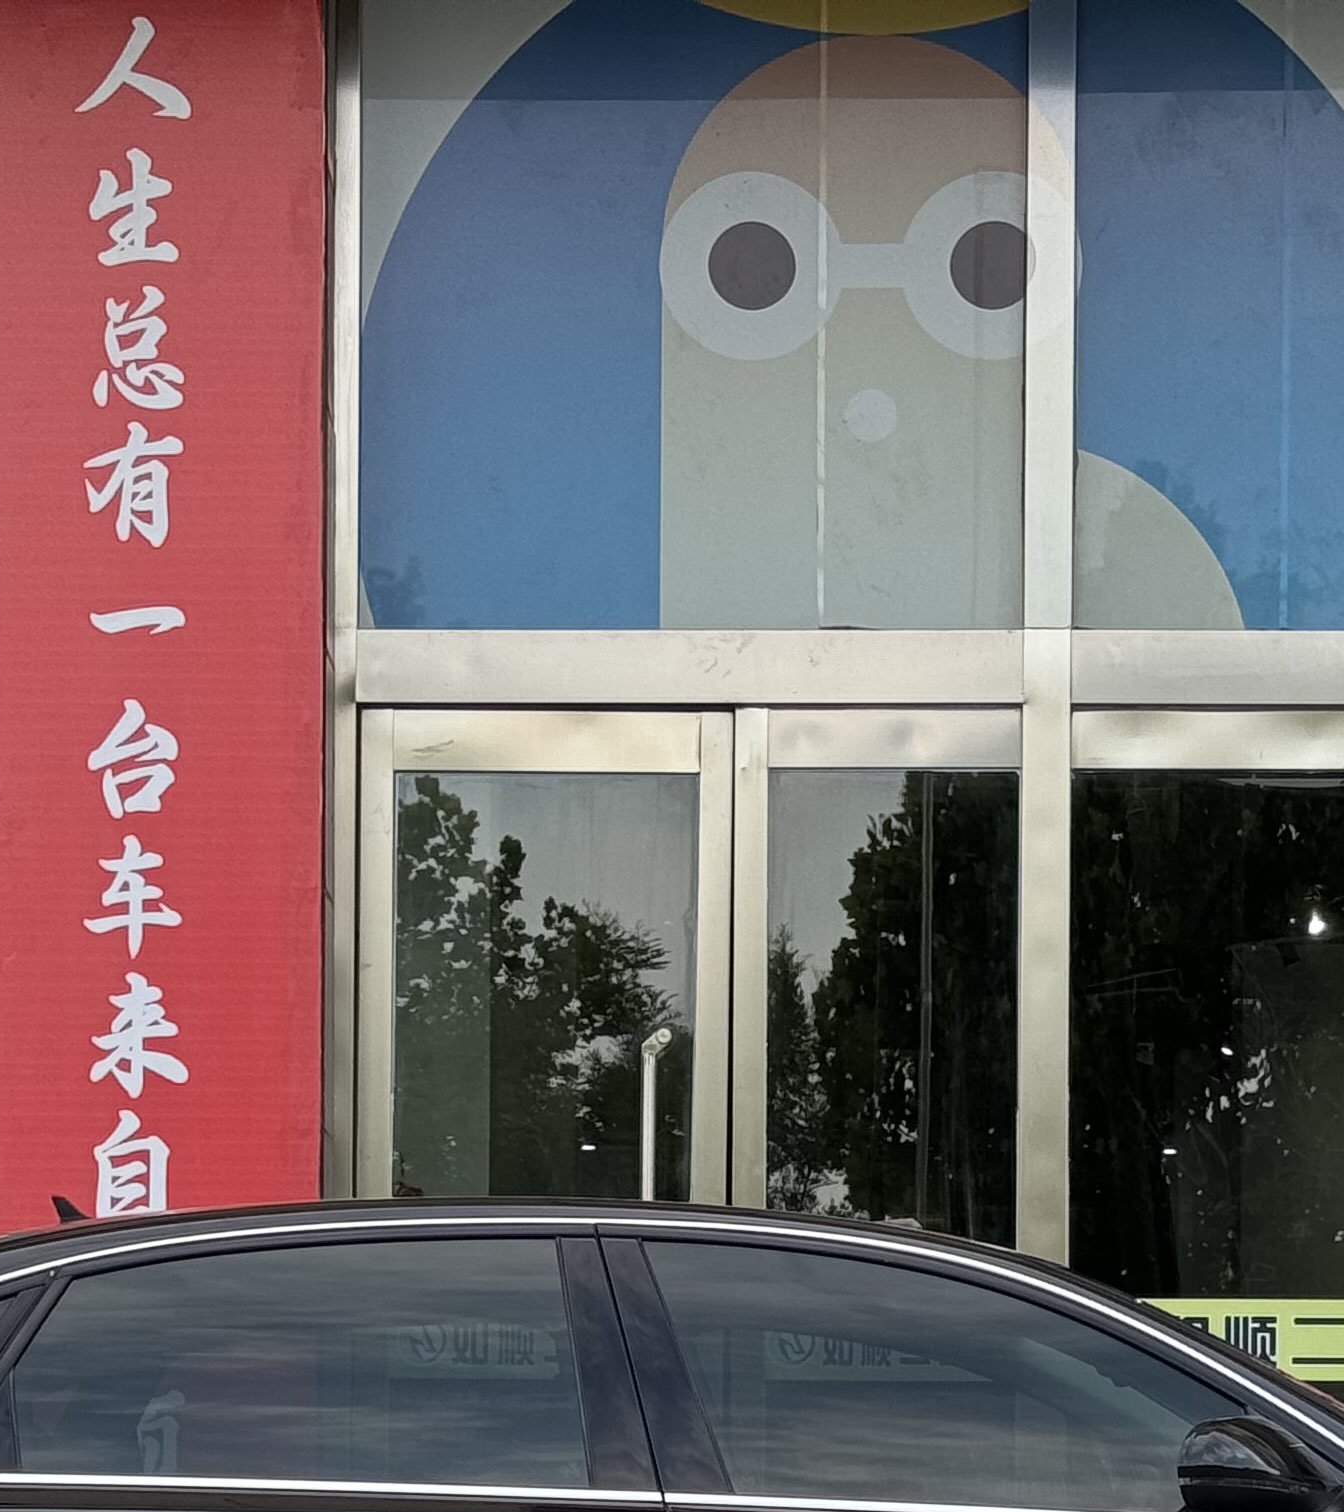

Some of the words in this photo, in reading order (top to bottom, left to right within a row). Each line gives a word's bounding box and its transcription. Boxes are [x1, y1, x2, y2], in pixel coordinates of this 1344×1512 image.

[74, 16, 193, 1217] 人生总有一台车来自
